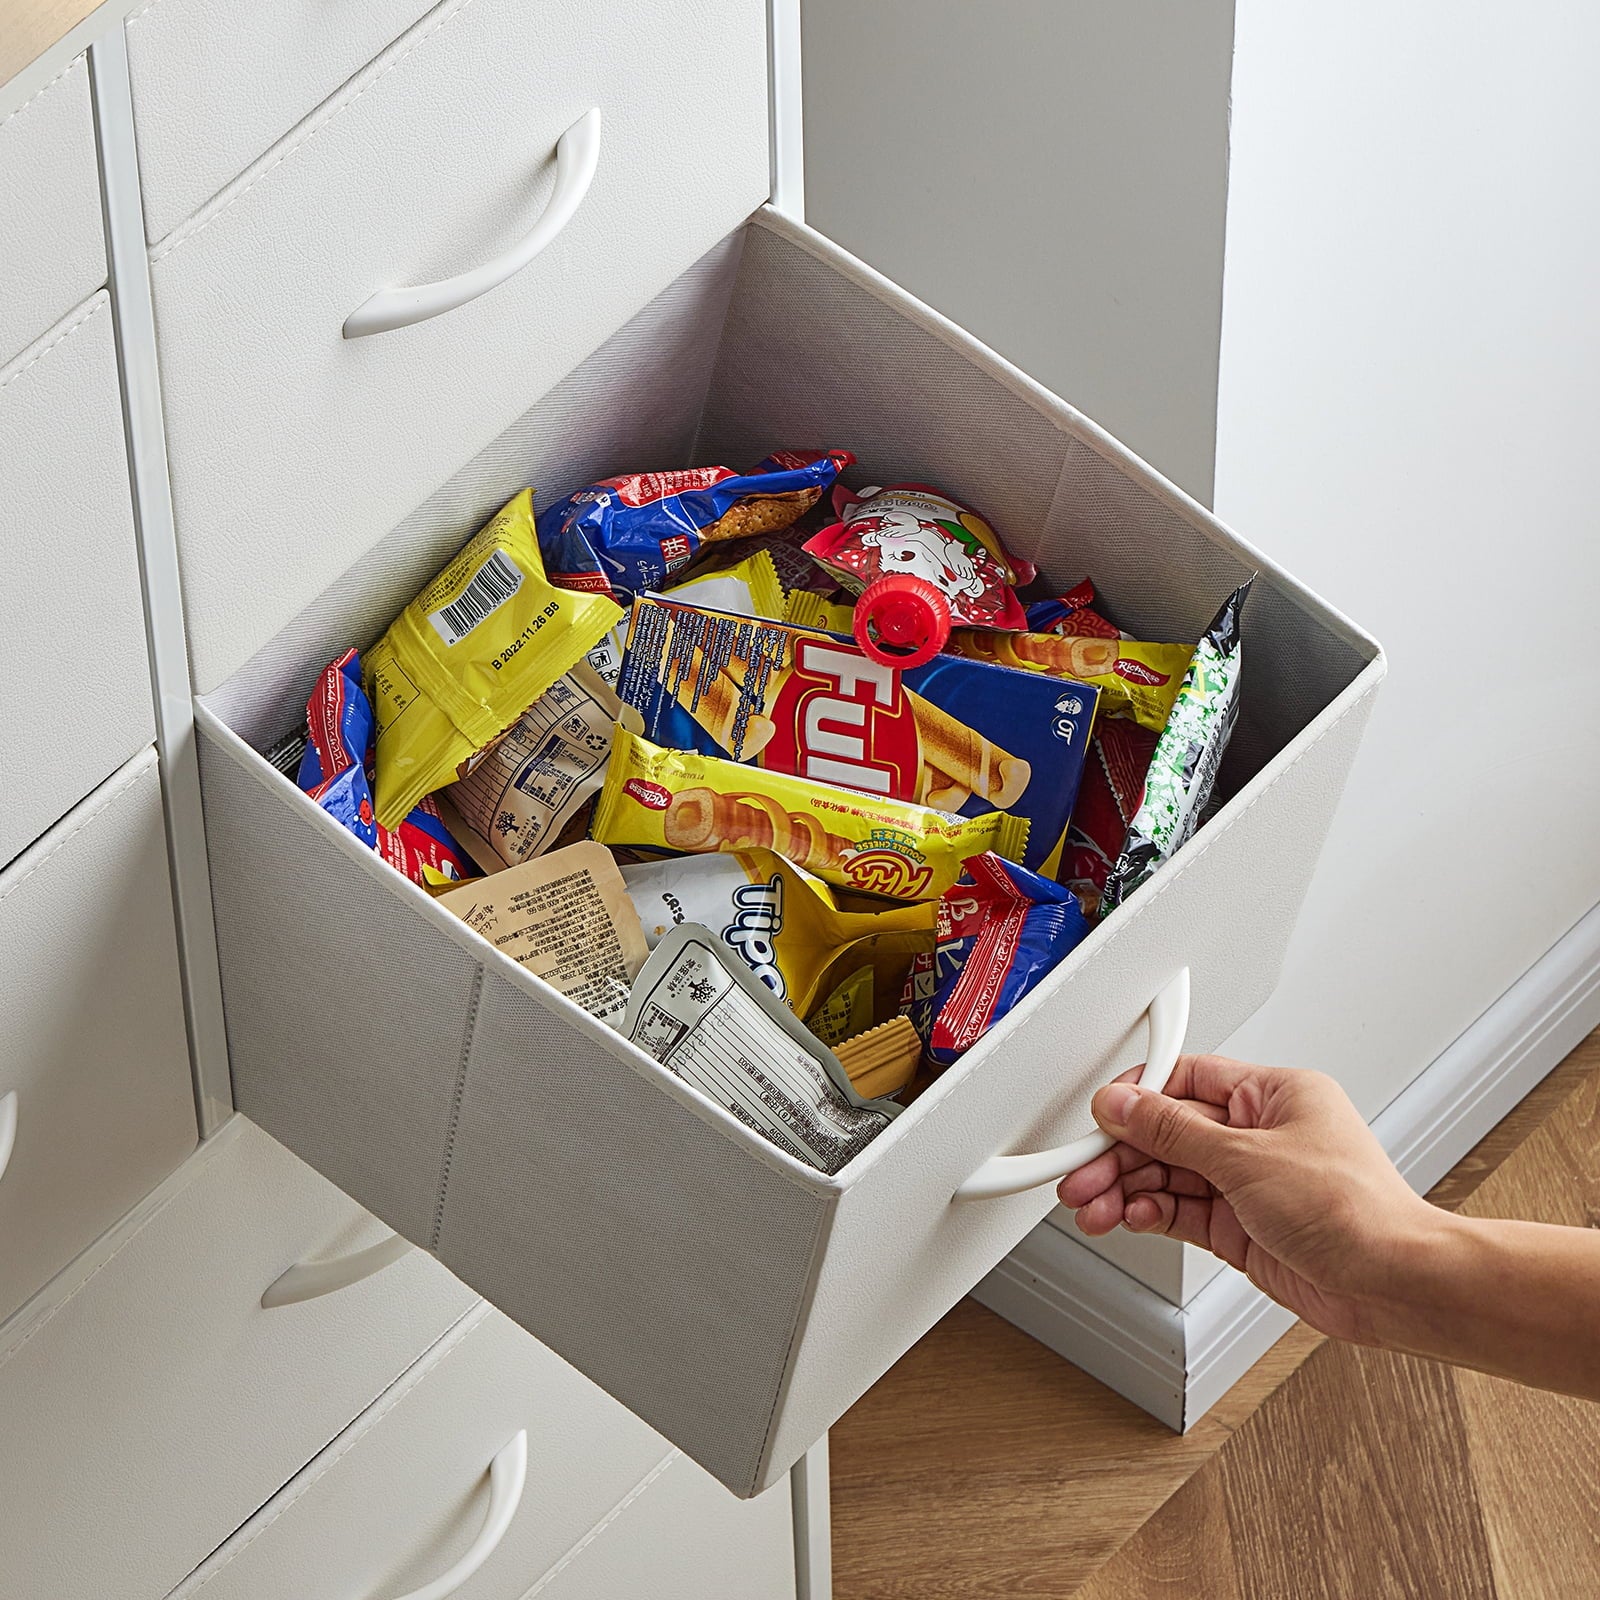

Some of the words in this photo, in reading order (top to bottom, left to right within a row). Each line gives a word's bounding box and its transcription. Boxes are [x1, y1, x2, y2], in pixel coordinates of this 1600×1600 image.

[658, 532, 691, 561] 饼
[491, 659, 502, 671] B
[500, 616, 547, 662] 2022.11.26
[543, 600, 560, 622] B8
[774, 630, 788, 660] Imported
[1117, 660, 1161, 684] Richeese
[627, 782, 673, 809] Richeese
[854, 838, 891, 851] CHEESE
[889, 839, 927, 865] DOUBLE
[721, 873, 787, 1001] Tipo
